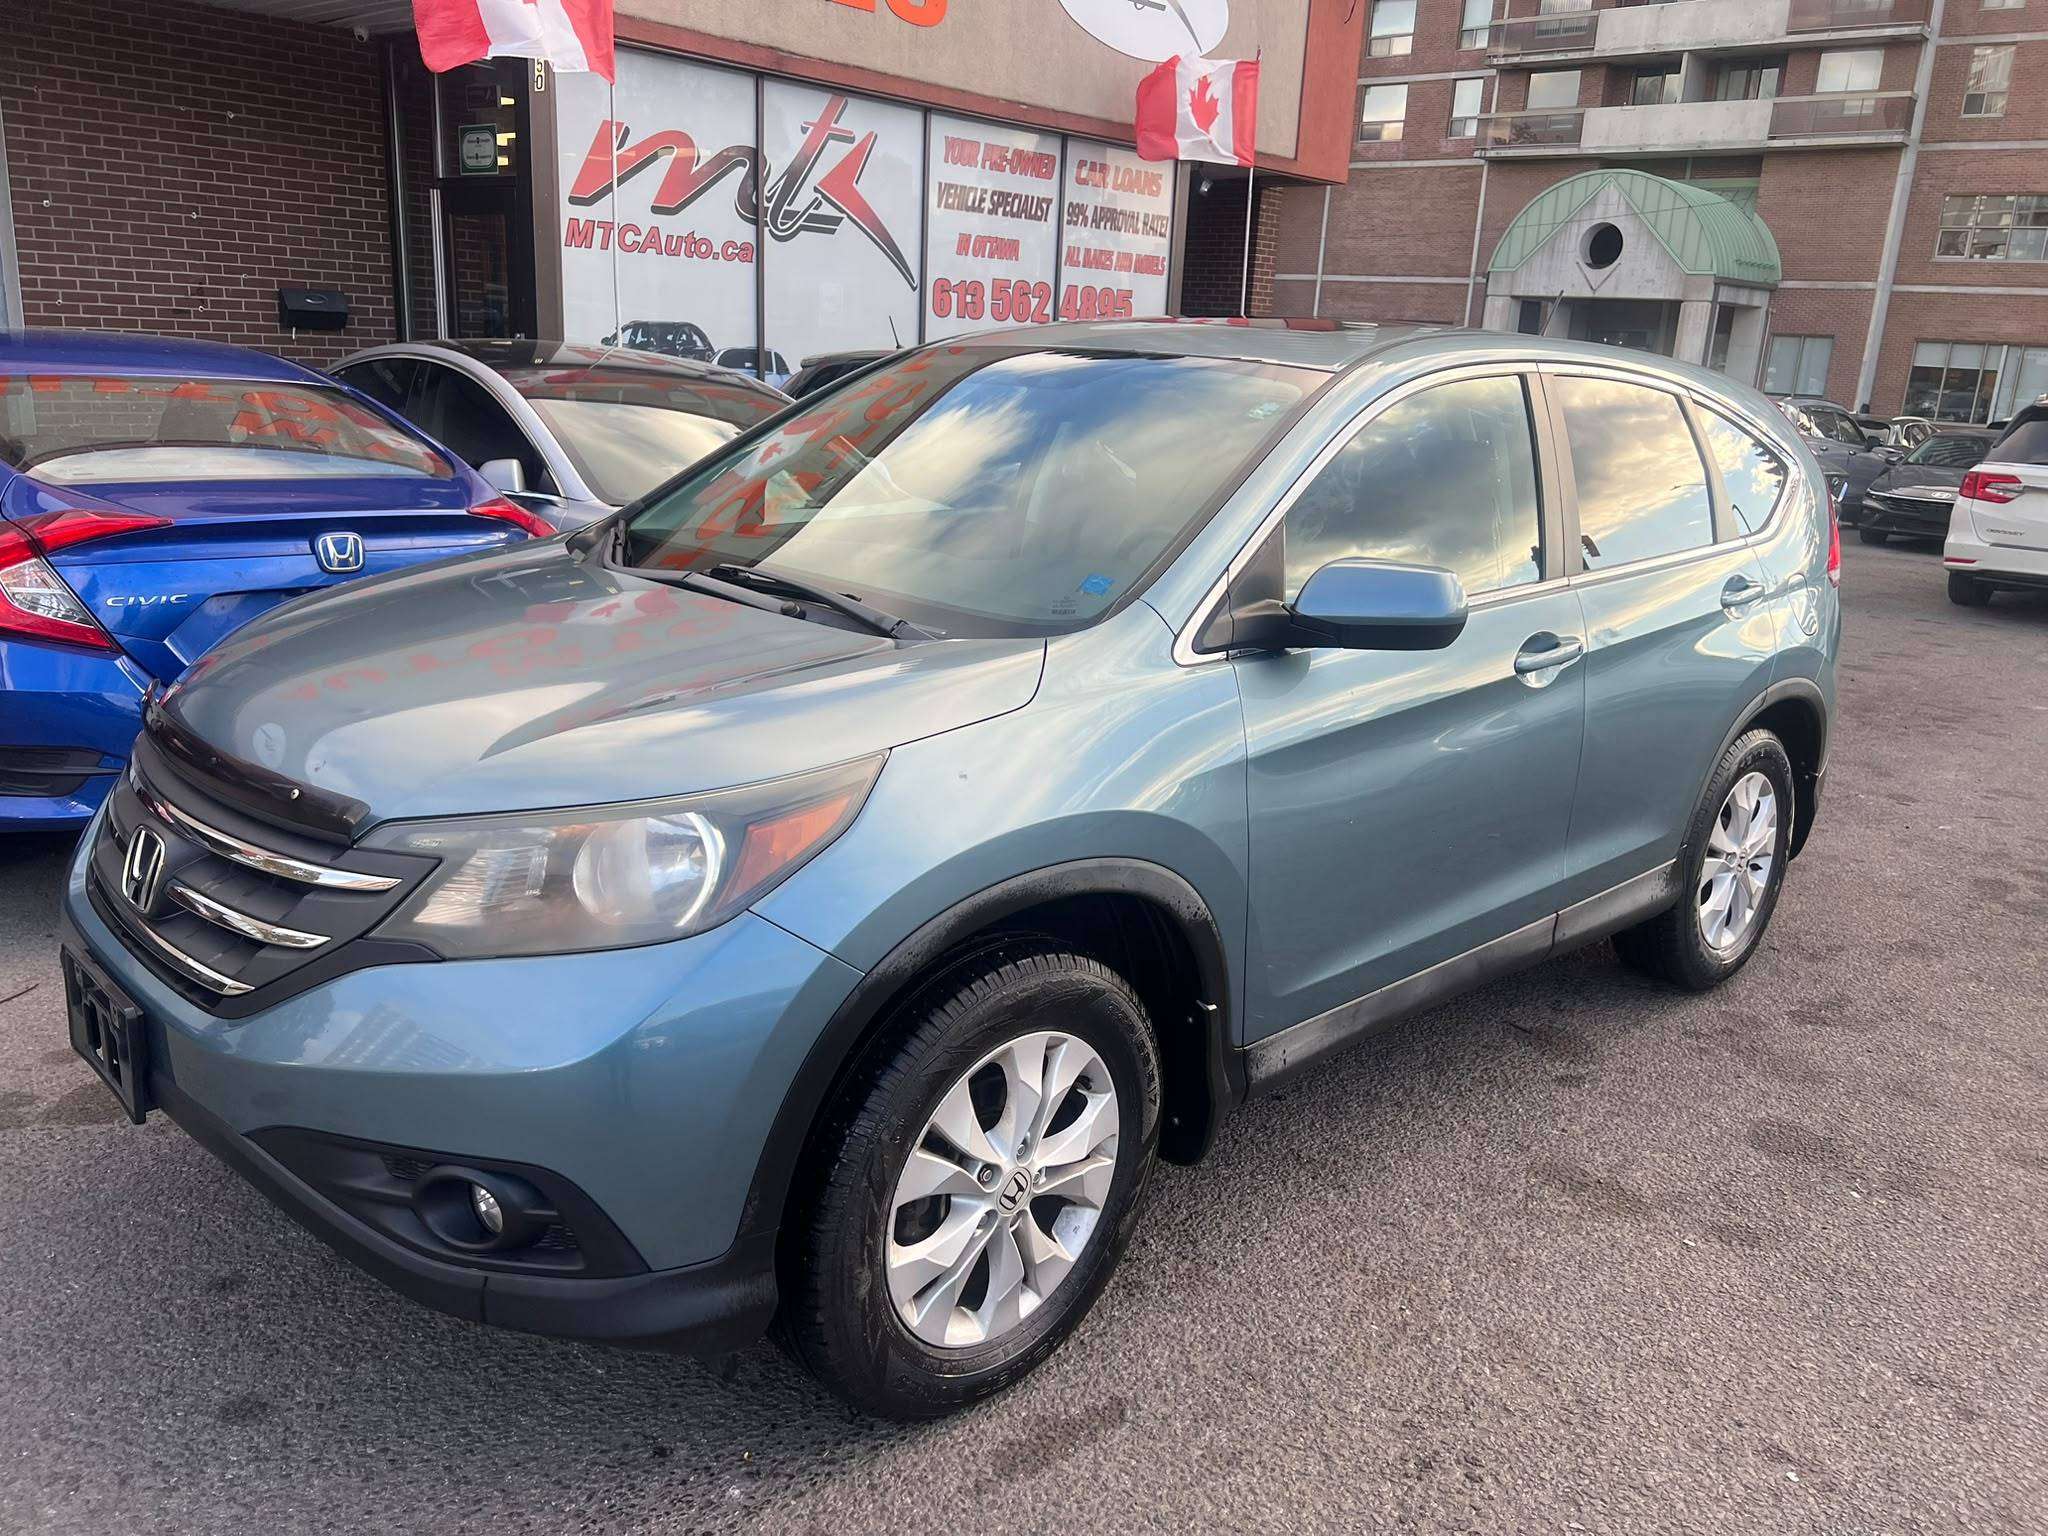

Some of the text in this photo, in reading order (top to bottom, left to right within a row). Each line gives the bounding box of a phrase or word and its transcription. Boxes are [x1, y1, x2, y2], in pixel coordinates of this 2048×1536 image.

[944, 136, 1056, 180] YOUR PRE-OWNED
[1075, 159, 1162, 197] CAR LOANS
[936, 181, 1055, 222] VEHICLE SPECIALIST
[1066, 201, 1089, 228] 99%
[1090, 204, 1140, 236] APPROVAL
[564, 217, 756, 264] MTCAuto.ca
[955, 232, 1020, 261] IN OTTAWA
[1064, 245, 1081, 269] ALL
[932, 277, 1133, 325] 613 562 4895
[106, 593, 189, 608] CIVIC
